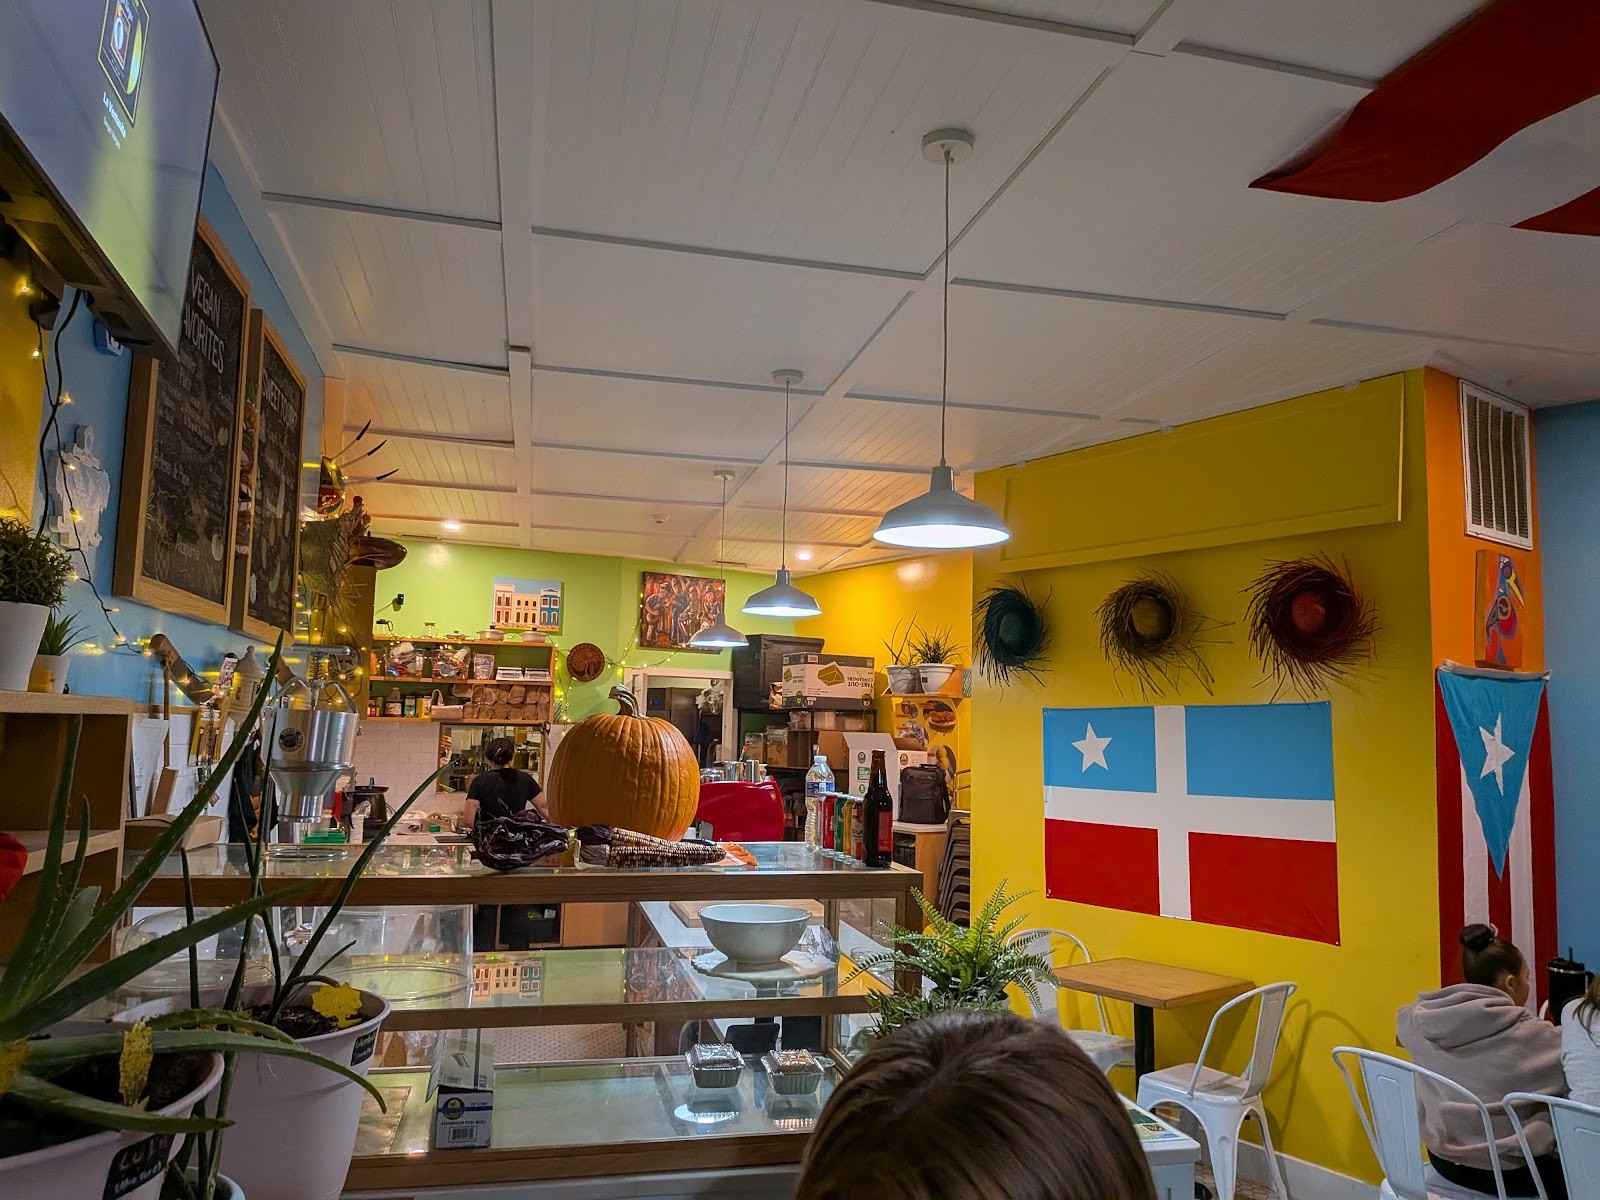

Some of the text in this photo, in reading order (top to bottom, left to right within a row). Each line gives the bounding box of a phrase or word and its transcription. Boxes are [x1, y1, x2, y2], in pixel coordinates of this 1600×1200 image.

[191, 265, 221, 329] VEGAN
[183, 302, 225, 374] AVORITES
[262, 368, 281, 413] SWEET
